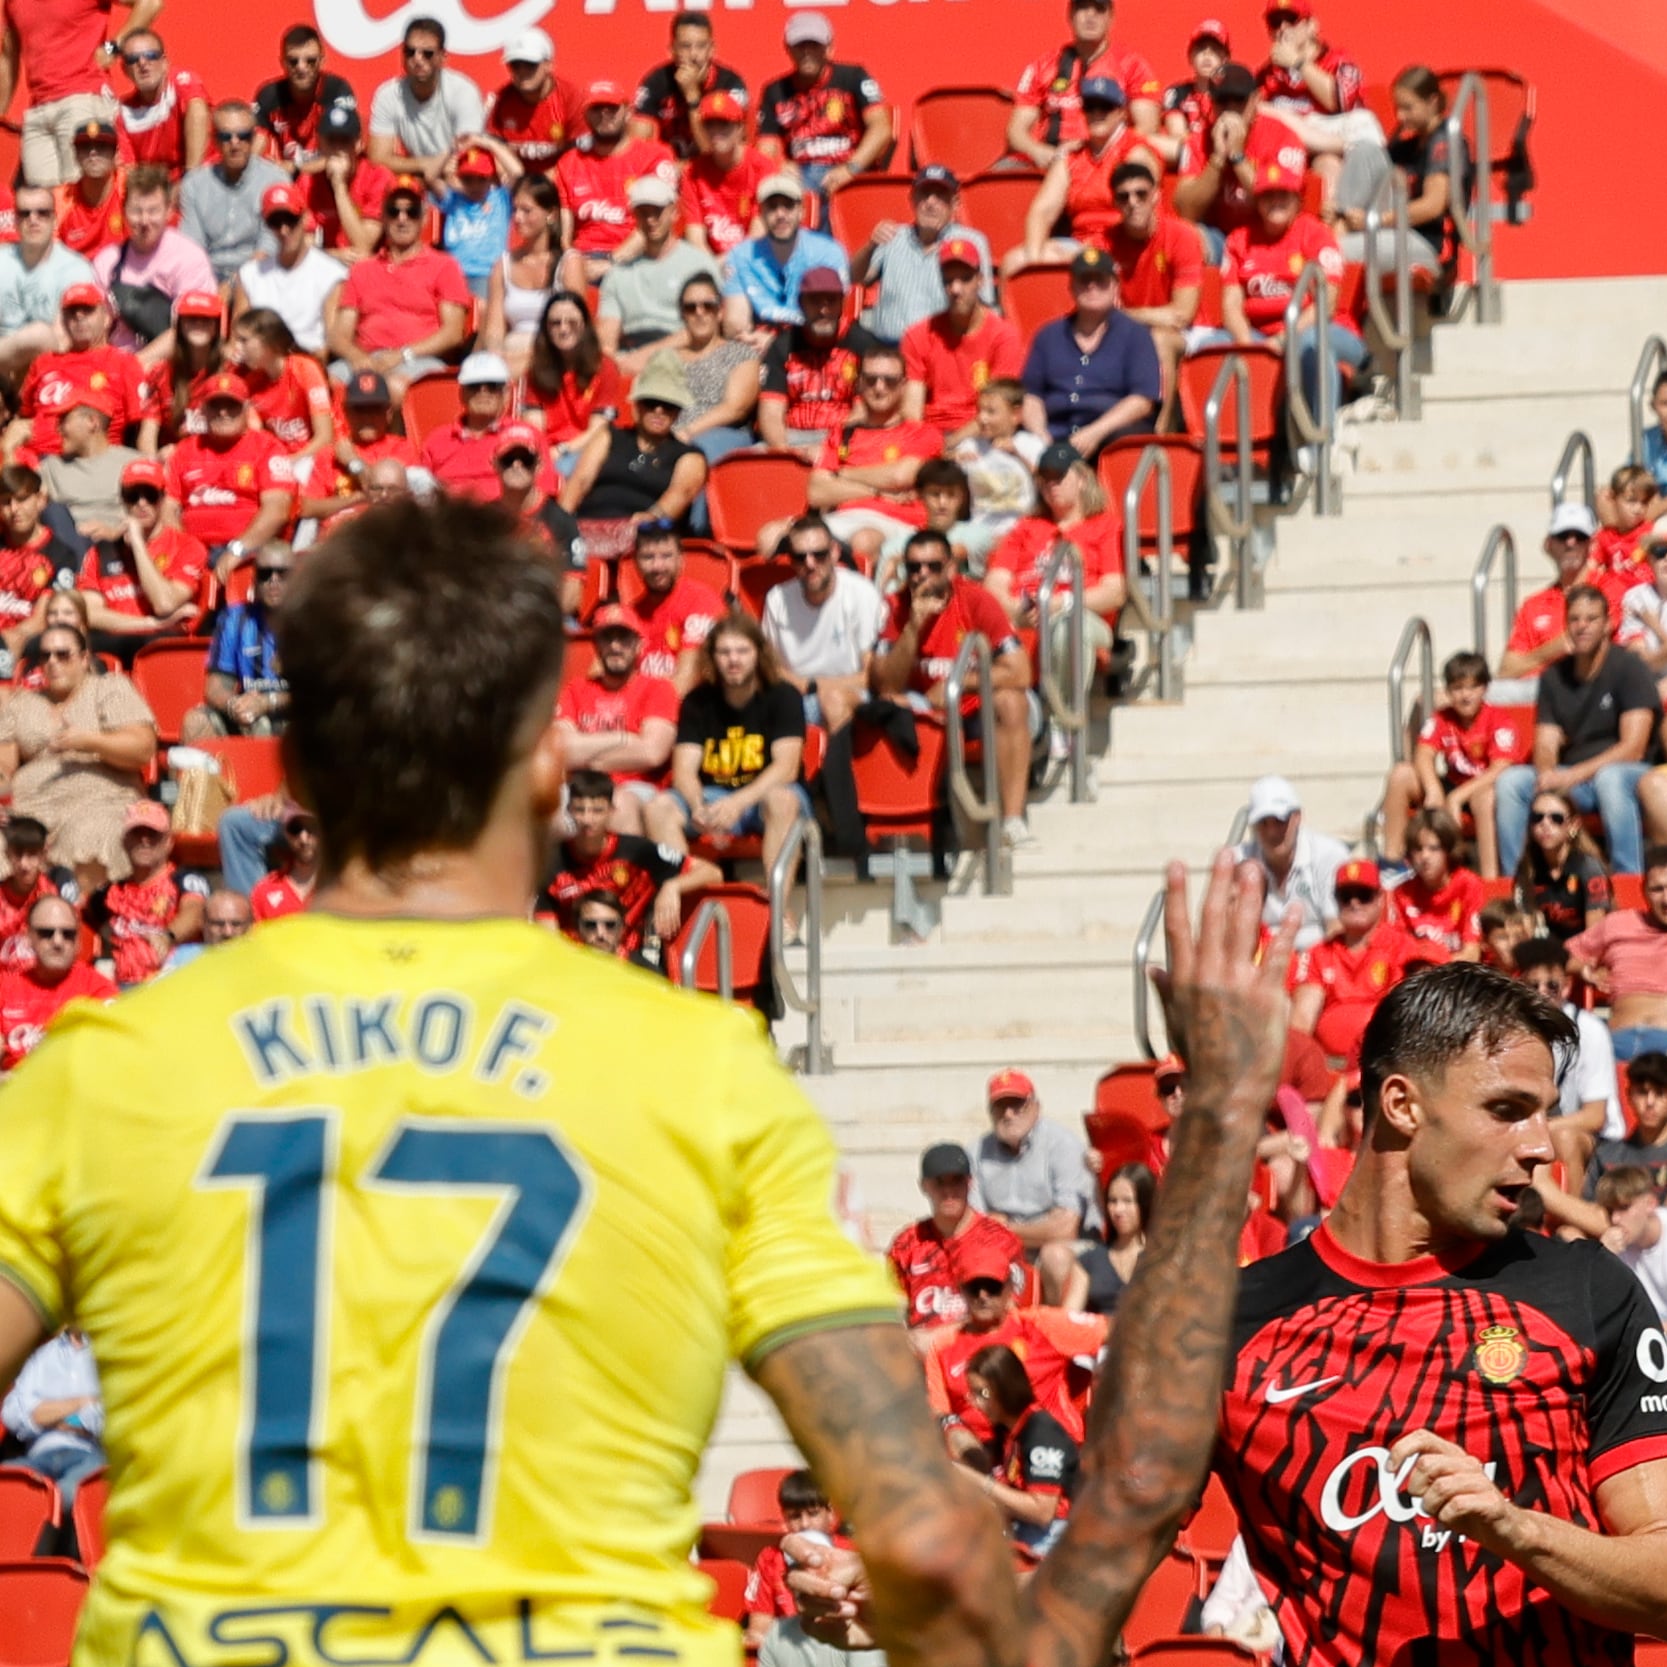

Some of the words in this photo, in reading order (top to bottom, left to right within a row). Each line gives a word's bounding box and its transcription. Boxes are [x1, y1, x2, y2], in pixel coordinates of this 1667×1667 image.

[230, 986, 472, 1088] KIKO
[474, 996, 558, 1098] F.
[193, 1106, 600, 1548] 17
[1421, 1523, 1451, 1552] by
